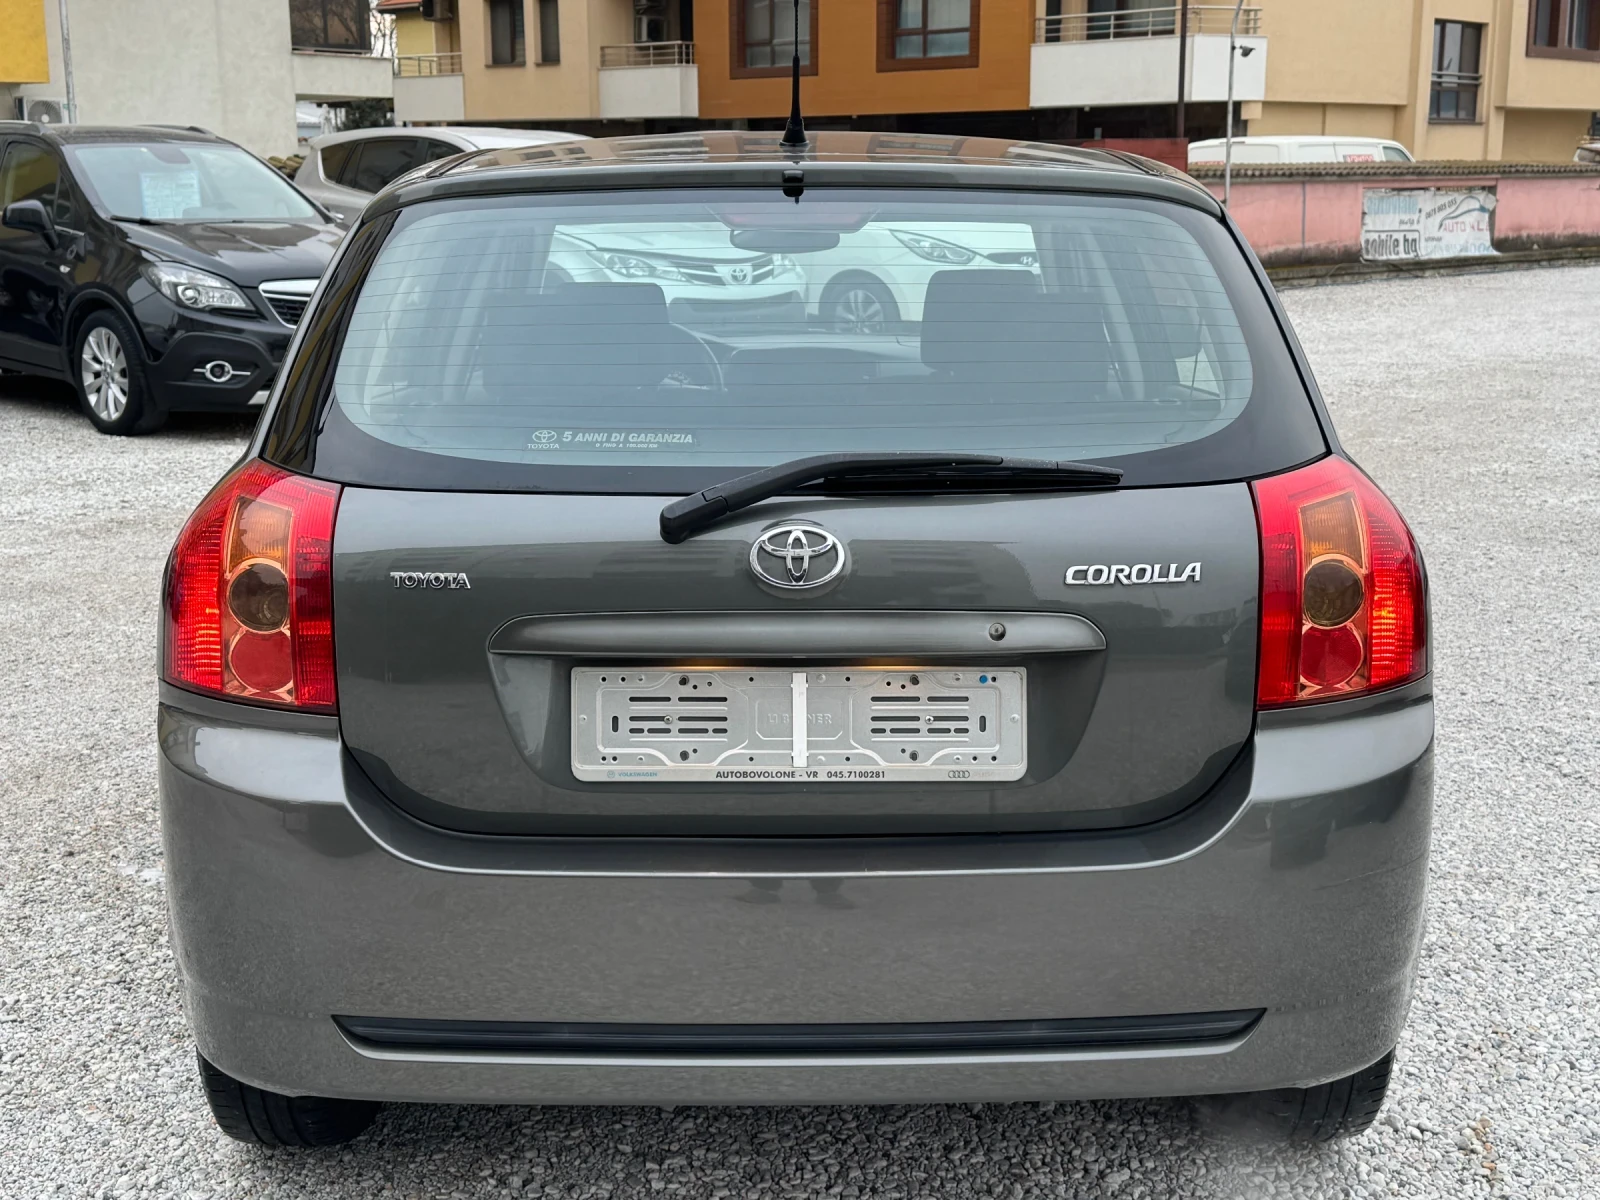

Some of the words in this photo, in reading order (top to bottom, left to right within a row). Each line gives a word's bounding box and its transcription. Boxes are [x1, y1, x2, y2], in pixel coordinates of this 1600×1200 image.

[562, 431, 573, 442] 5
[574, 432, 607, 442] ANNI
[610, 432, 626, 442] DI
[628, 433, 693, 444] GARANZIA
[390, 571, 471, 589] TOYOTA
[1064, 562, 1202, 585] COROLLA
[715, 771, 796, 779] AUTOBOVOLONE
[806, 771, 819, 779] VR
[826, 771, 885, 779] 045.7100281
